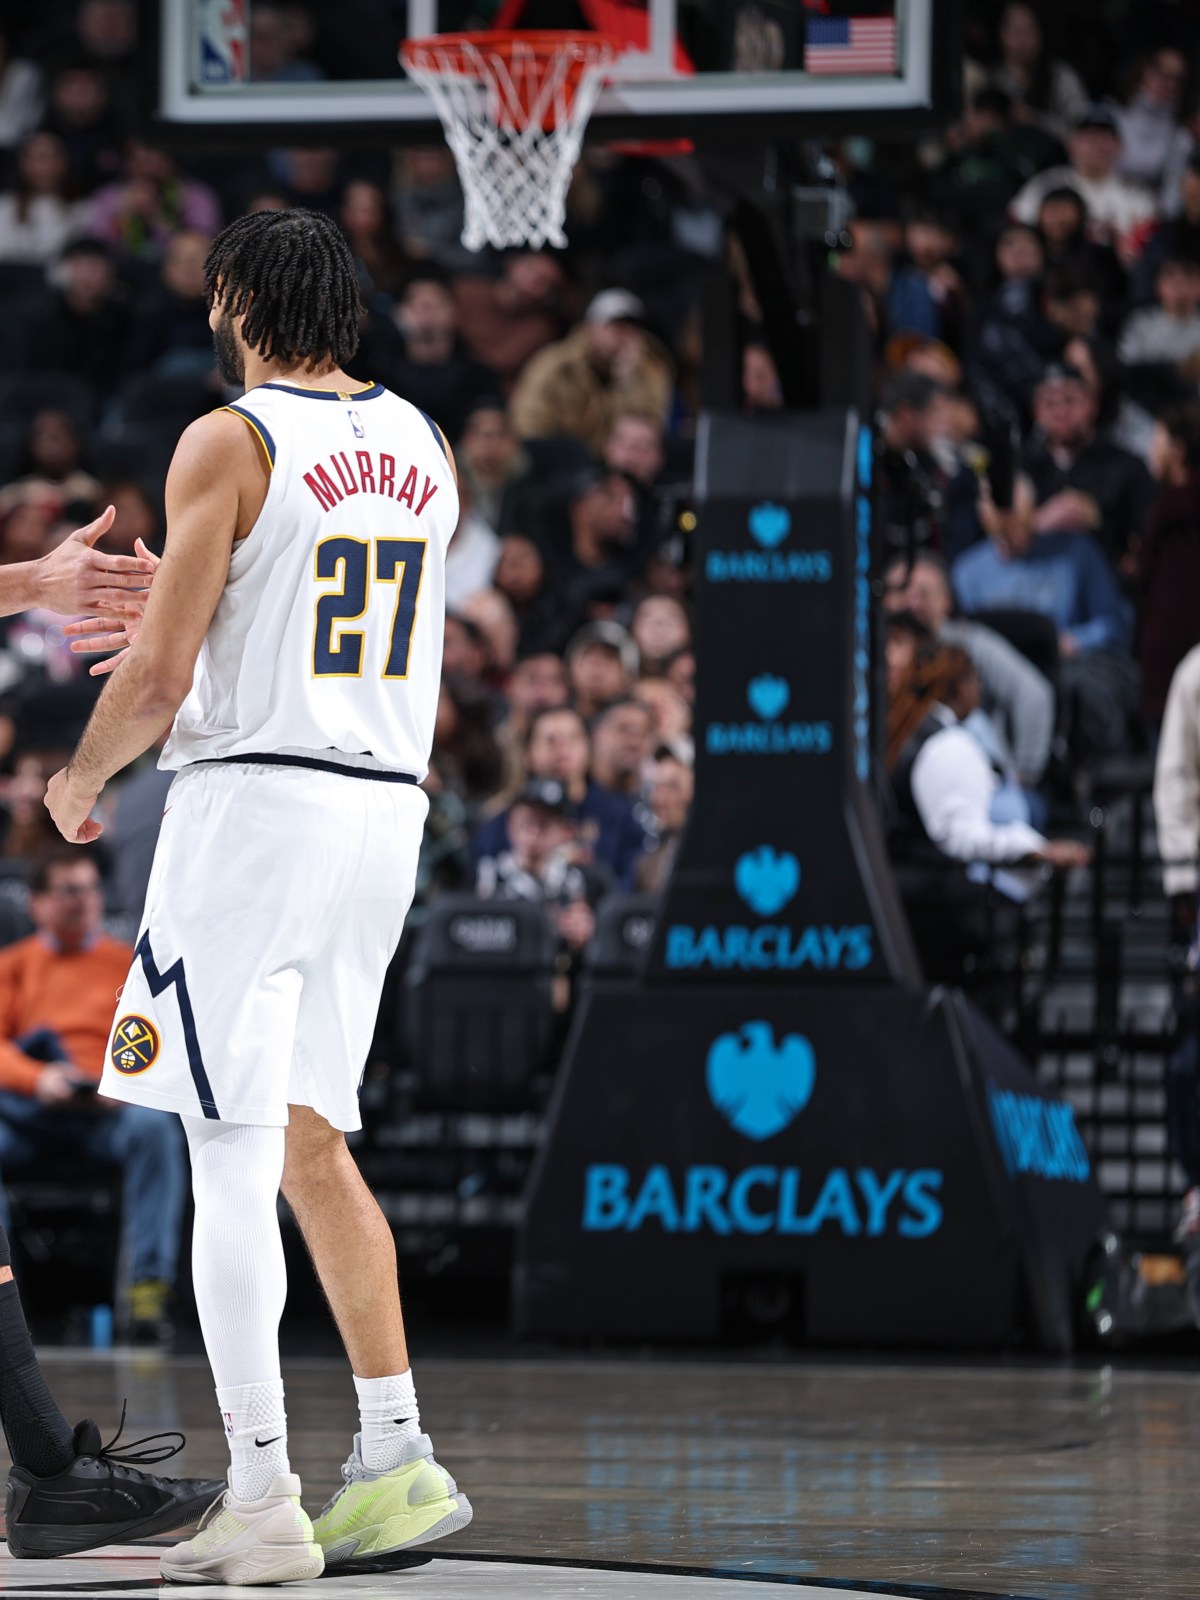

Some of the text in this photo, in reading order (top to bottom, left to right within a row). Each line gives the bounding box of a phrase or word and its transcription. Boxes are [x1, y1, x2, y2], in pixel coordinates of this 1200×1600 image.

[303, 450, 438, 517] MURRAY
[312, 534, 428, 680] 27
[666, 924, 872, 971] BARCLAYS
[582, 1163, 943, 1238] BARCLAYS
